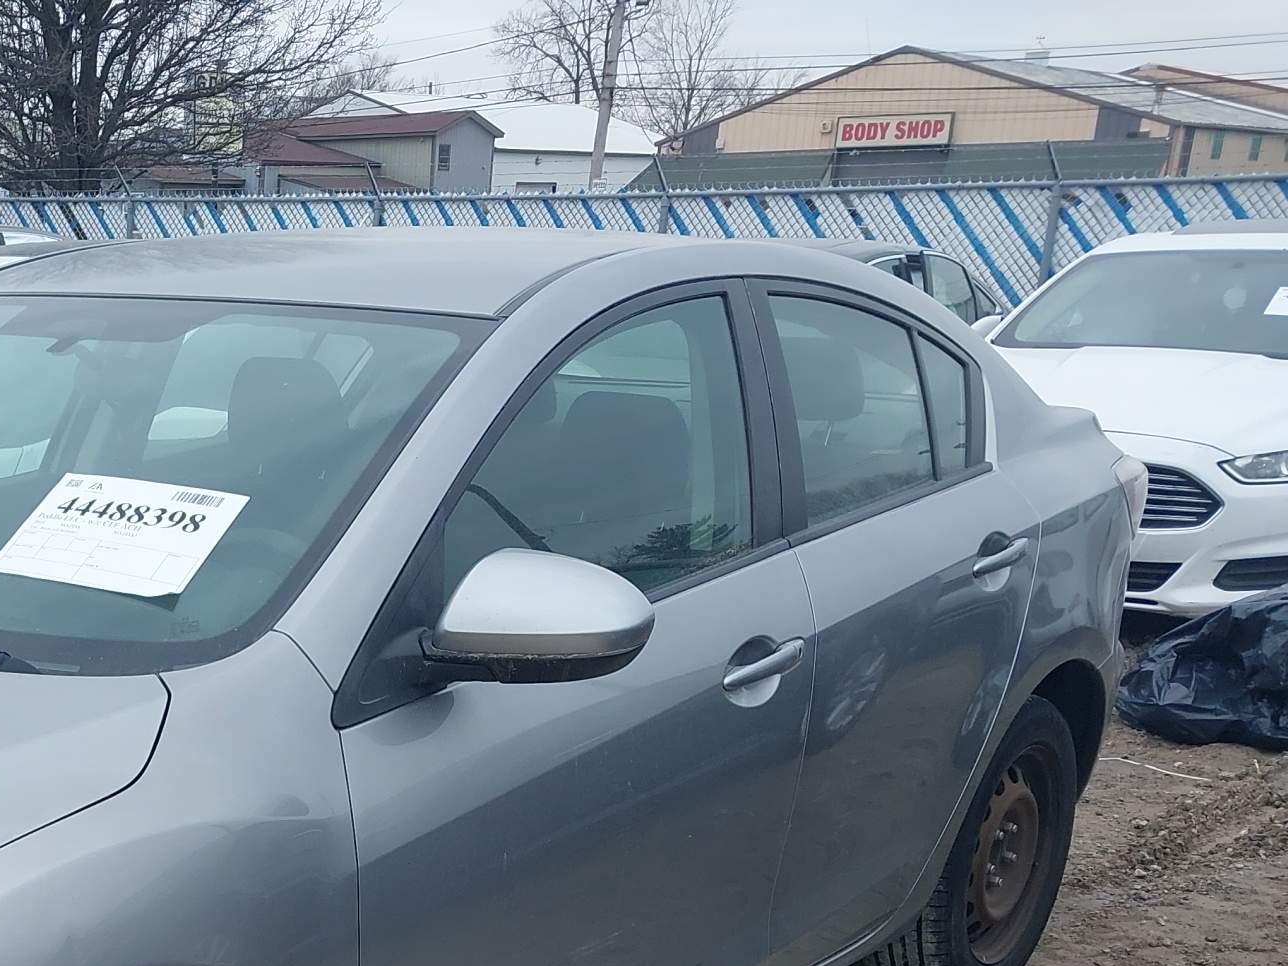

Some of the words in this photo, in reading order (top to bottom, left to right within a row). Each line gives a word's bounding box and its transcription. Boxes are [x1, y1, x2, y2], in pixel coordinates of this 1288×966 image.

[841, 122, 890, 142] BODY
[894, 119, 945, 140] SHOP
[57, 497, 207, 533] 44488398
